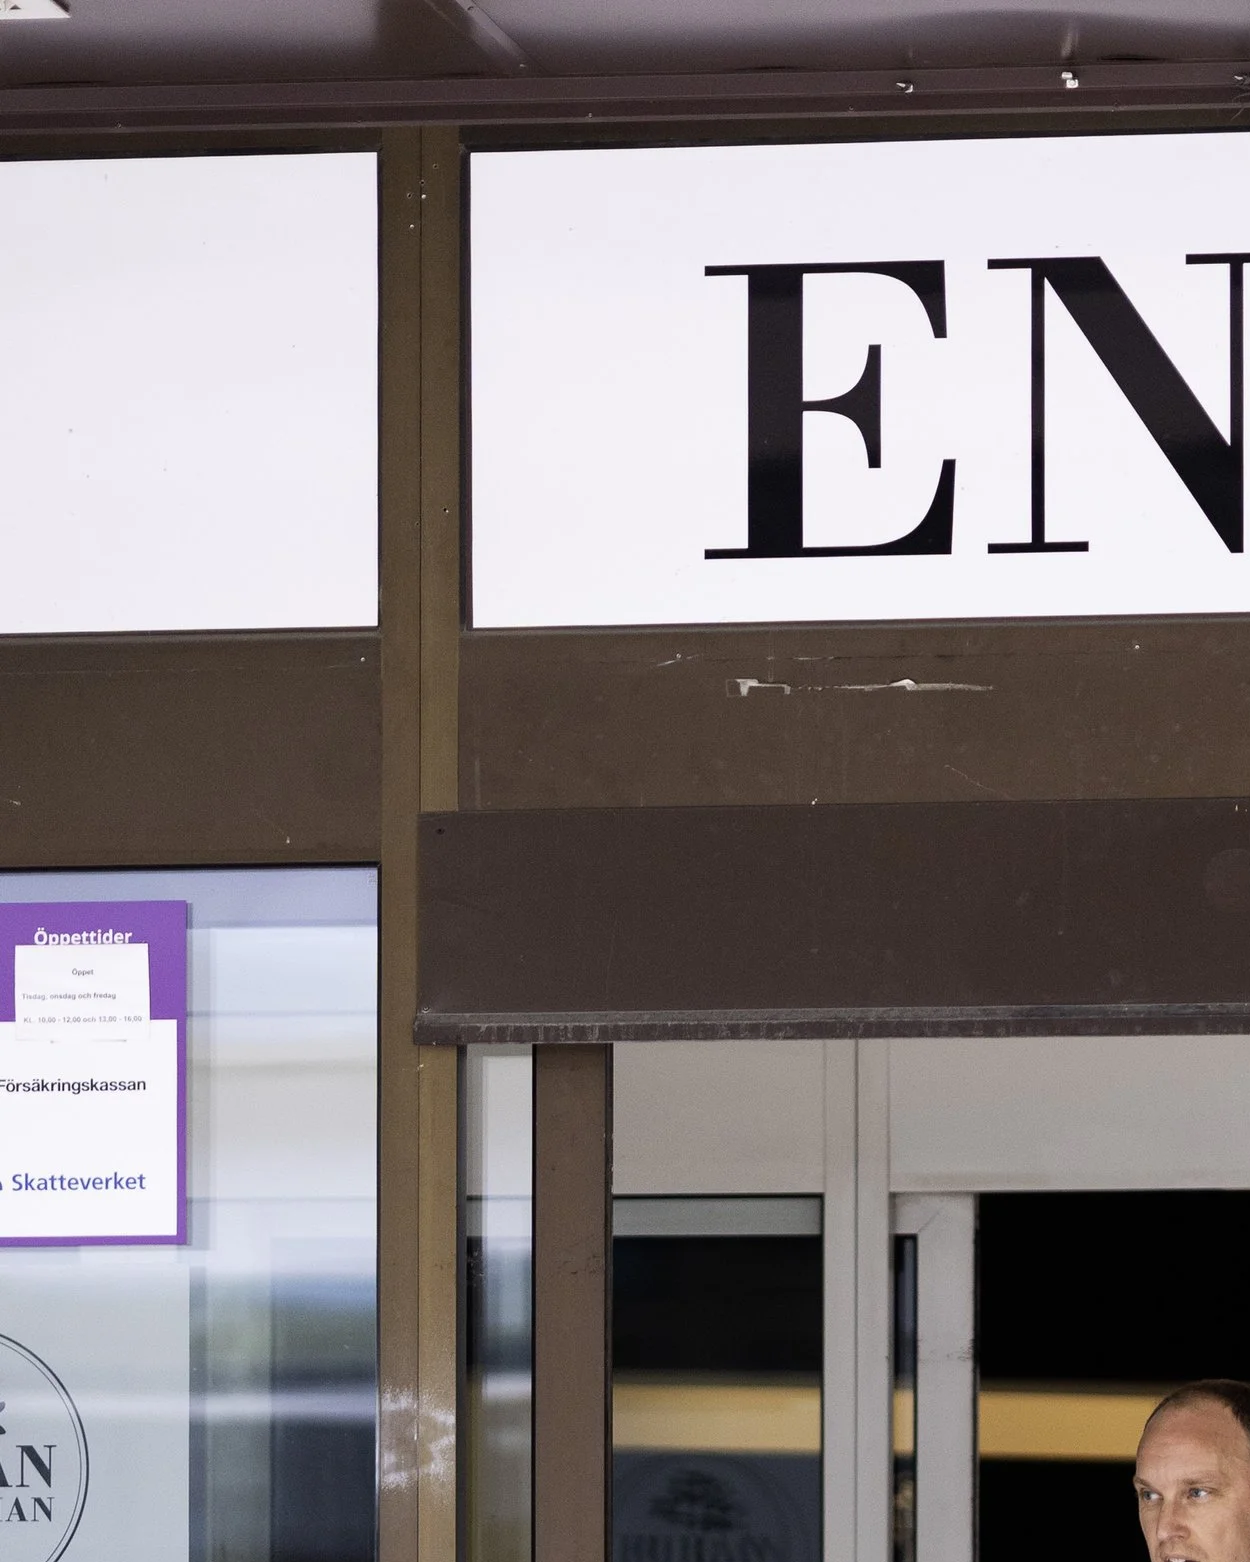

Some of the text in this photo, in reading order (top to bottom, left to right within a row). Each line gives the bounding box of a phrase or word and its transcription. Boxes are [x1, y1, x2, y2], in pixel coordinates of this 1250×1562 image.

[34, 927, 132, 945] Öppettider
[72, 968, 94, 976] Öppet
[50, 993, 76, 1001] onsdag
[78, 992, 92, 1000] och
[93, 992, 117, 1000] fredag
[12, 1171, 146, 1191] Skatteverket
